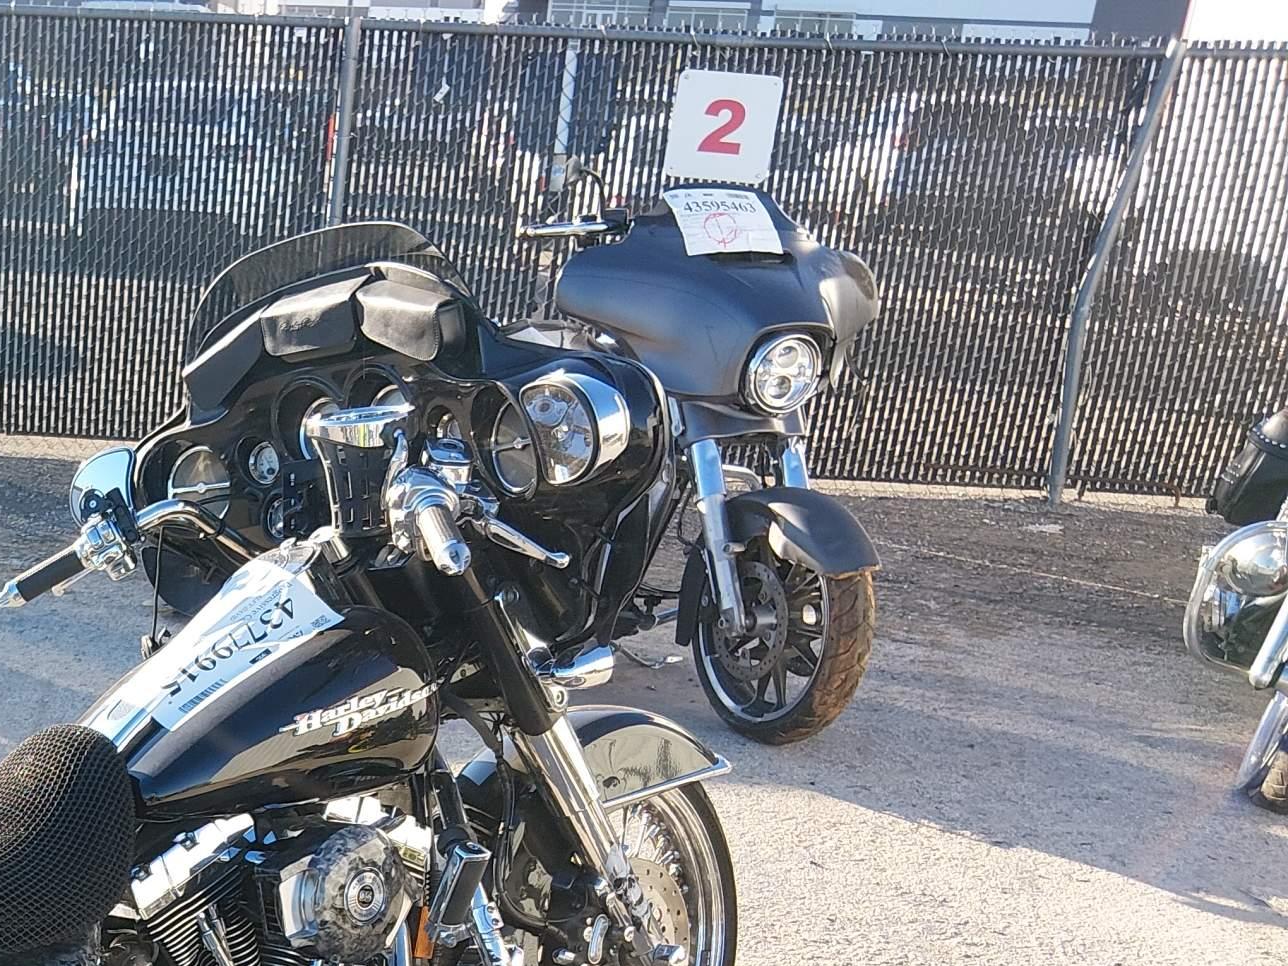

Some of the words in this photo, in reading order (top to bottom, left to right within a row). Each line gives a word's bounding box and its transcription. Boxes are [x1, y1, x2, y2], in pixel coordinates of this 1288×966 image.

[696, 98, 747, 156] 2
[683, 199, 757, 214] 43595463
[160, 597, 295, 698] 43779915
